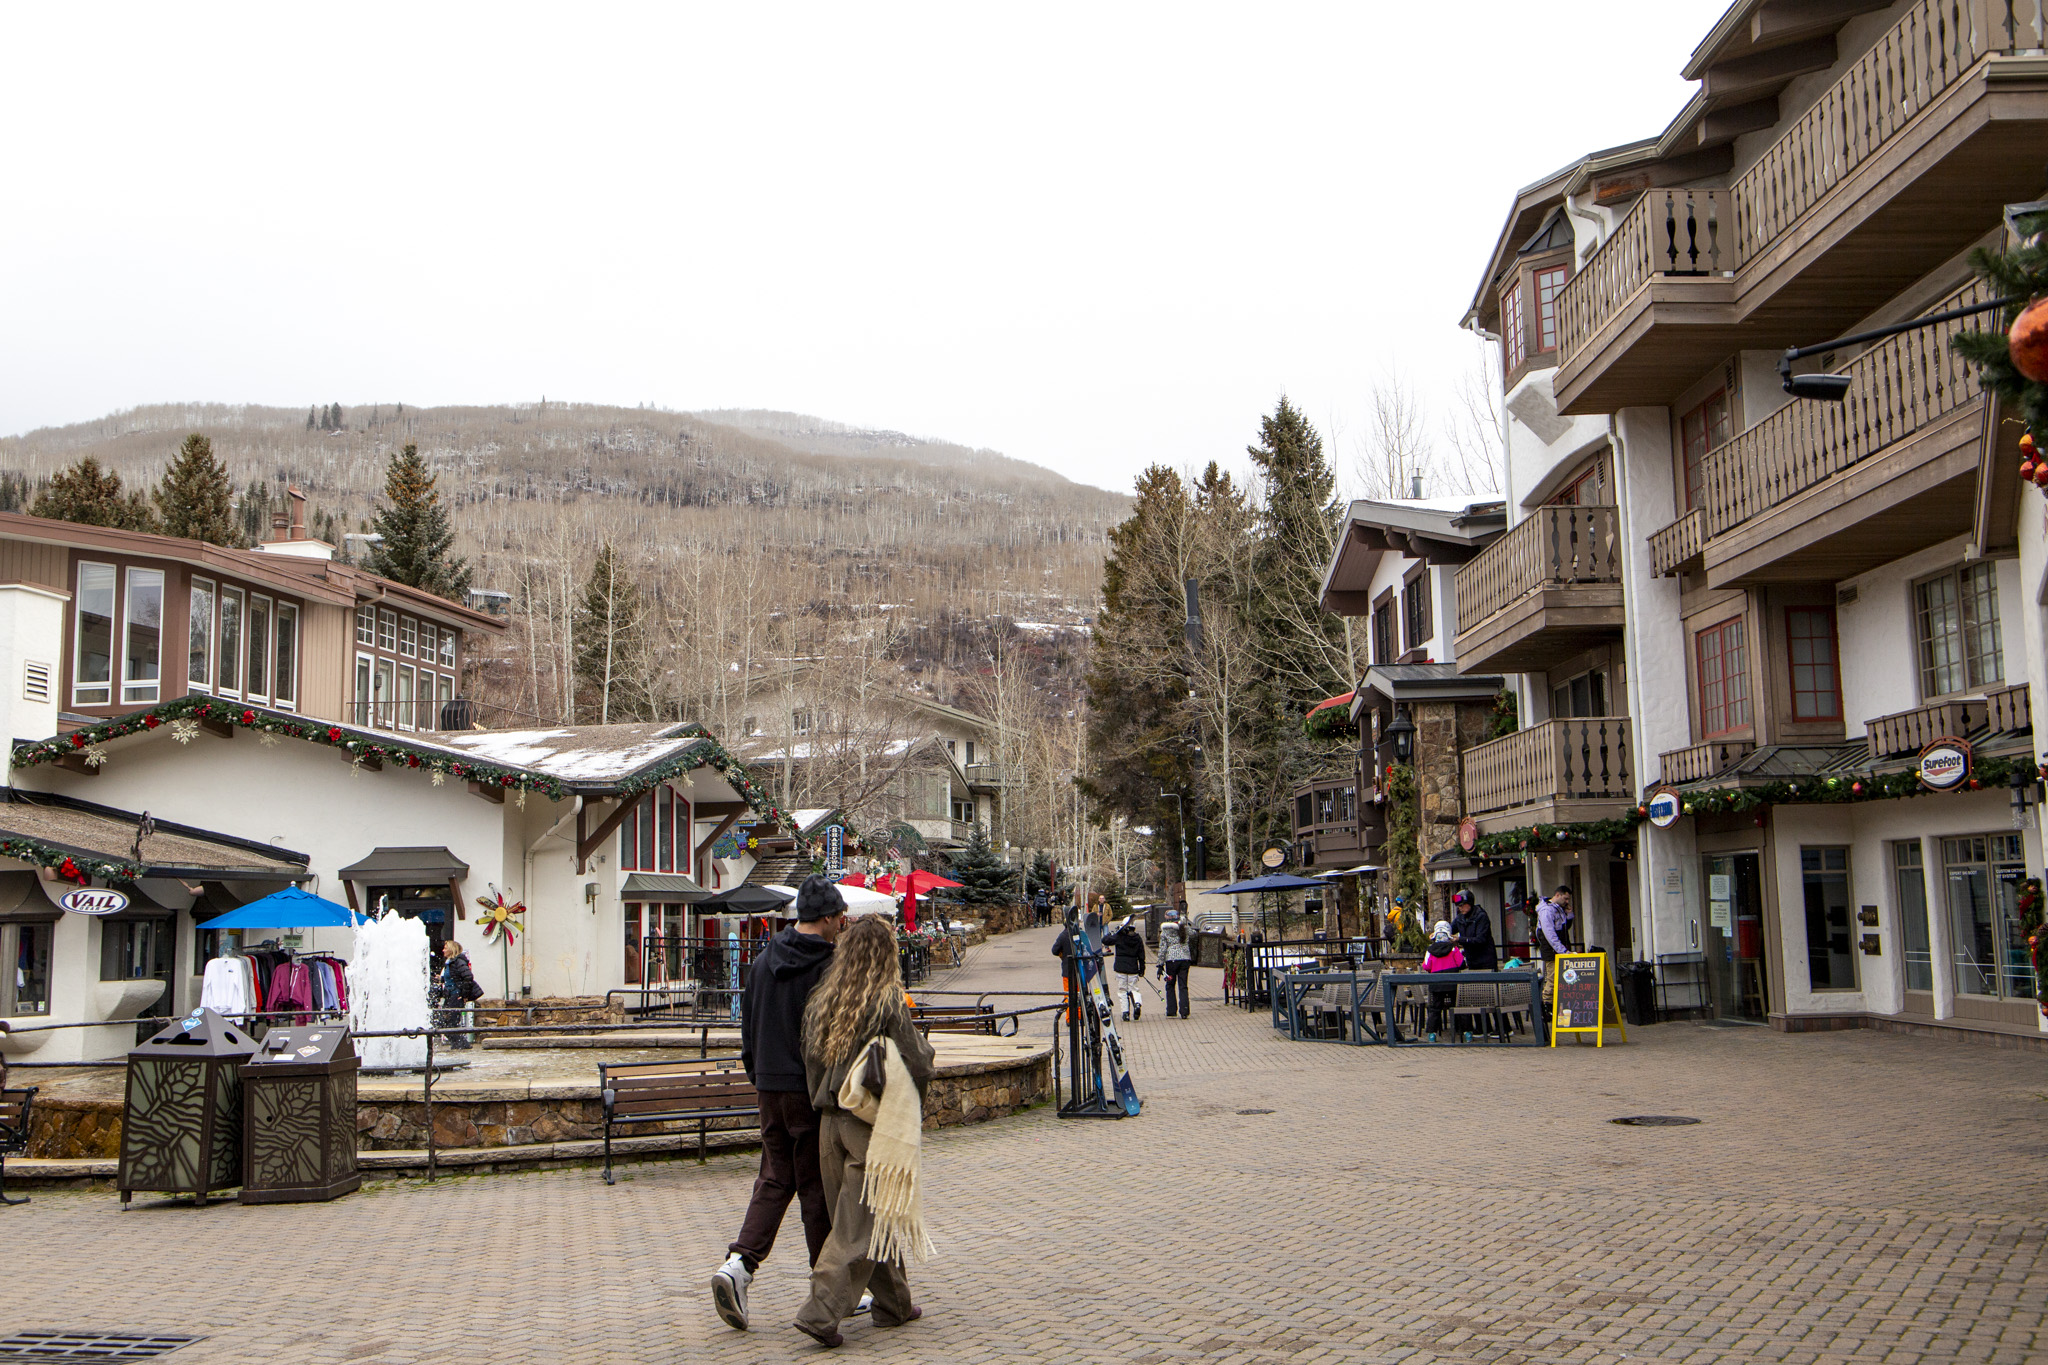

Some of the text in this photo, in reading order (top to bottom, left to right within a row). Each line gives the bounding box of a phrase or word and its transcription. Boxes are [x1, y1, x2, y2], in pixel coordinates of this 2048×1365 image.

[1924, 755, 1961, 770] Surefoot
[831, 827, 839, 869] SHAKEDOWN
[71, 893, 116, 909] VAIL
[1563, 959, 1596, 970] PACIFICO
[1558, 983, 1571, 991] BUY
[1583, 1000, 1599, 1010] PRICE
[1573, 1011, 1593, 1024] BEER
